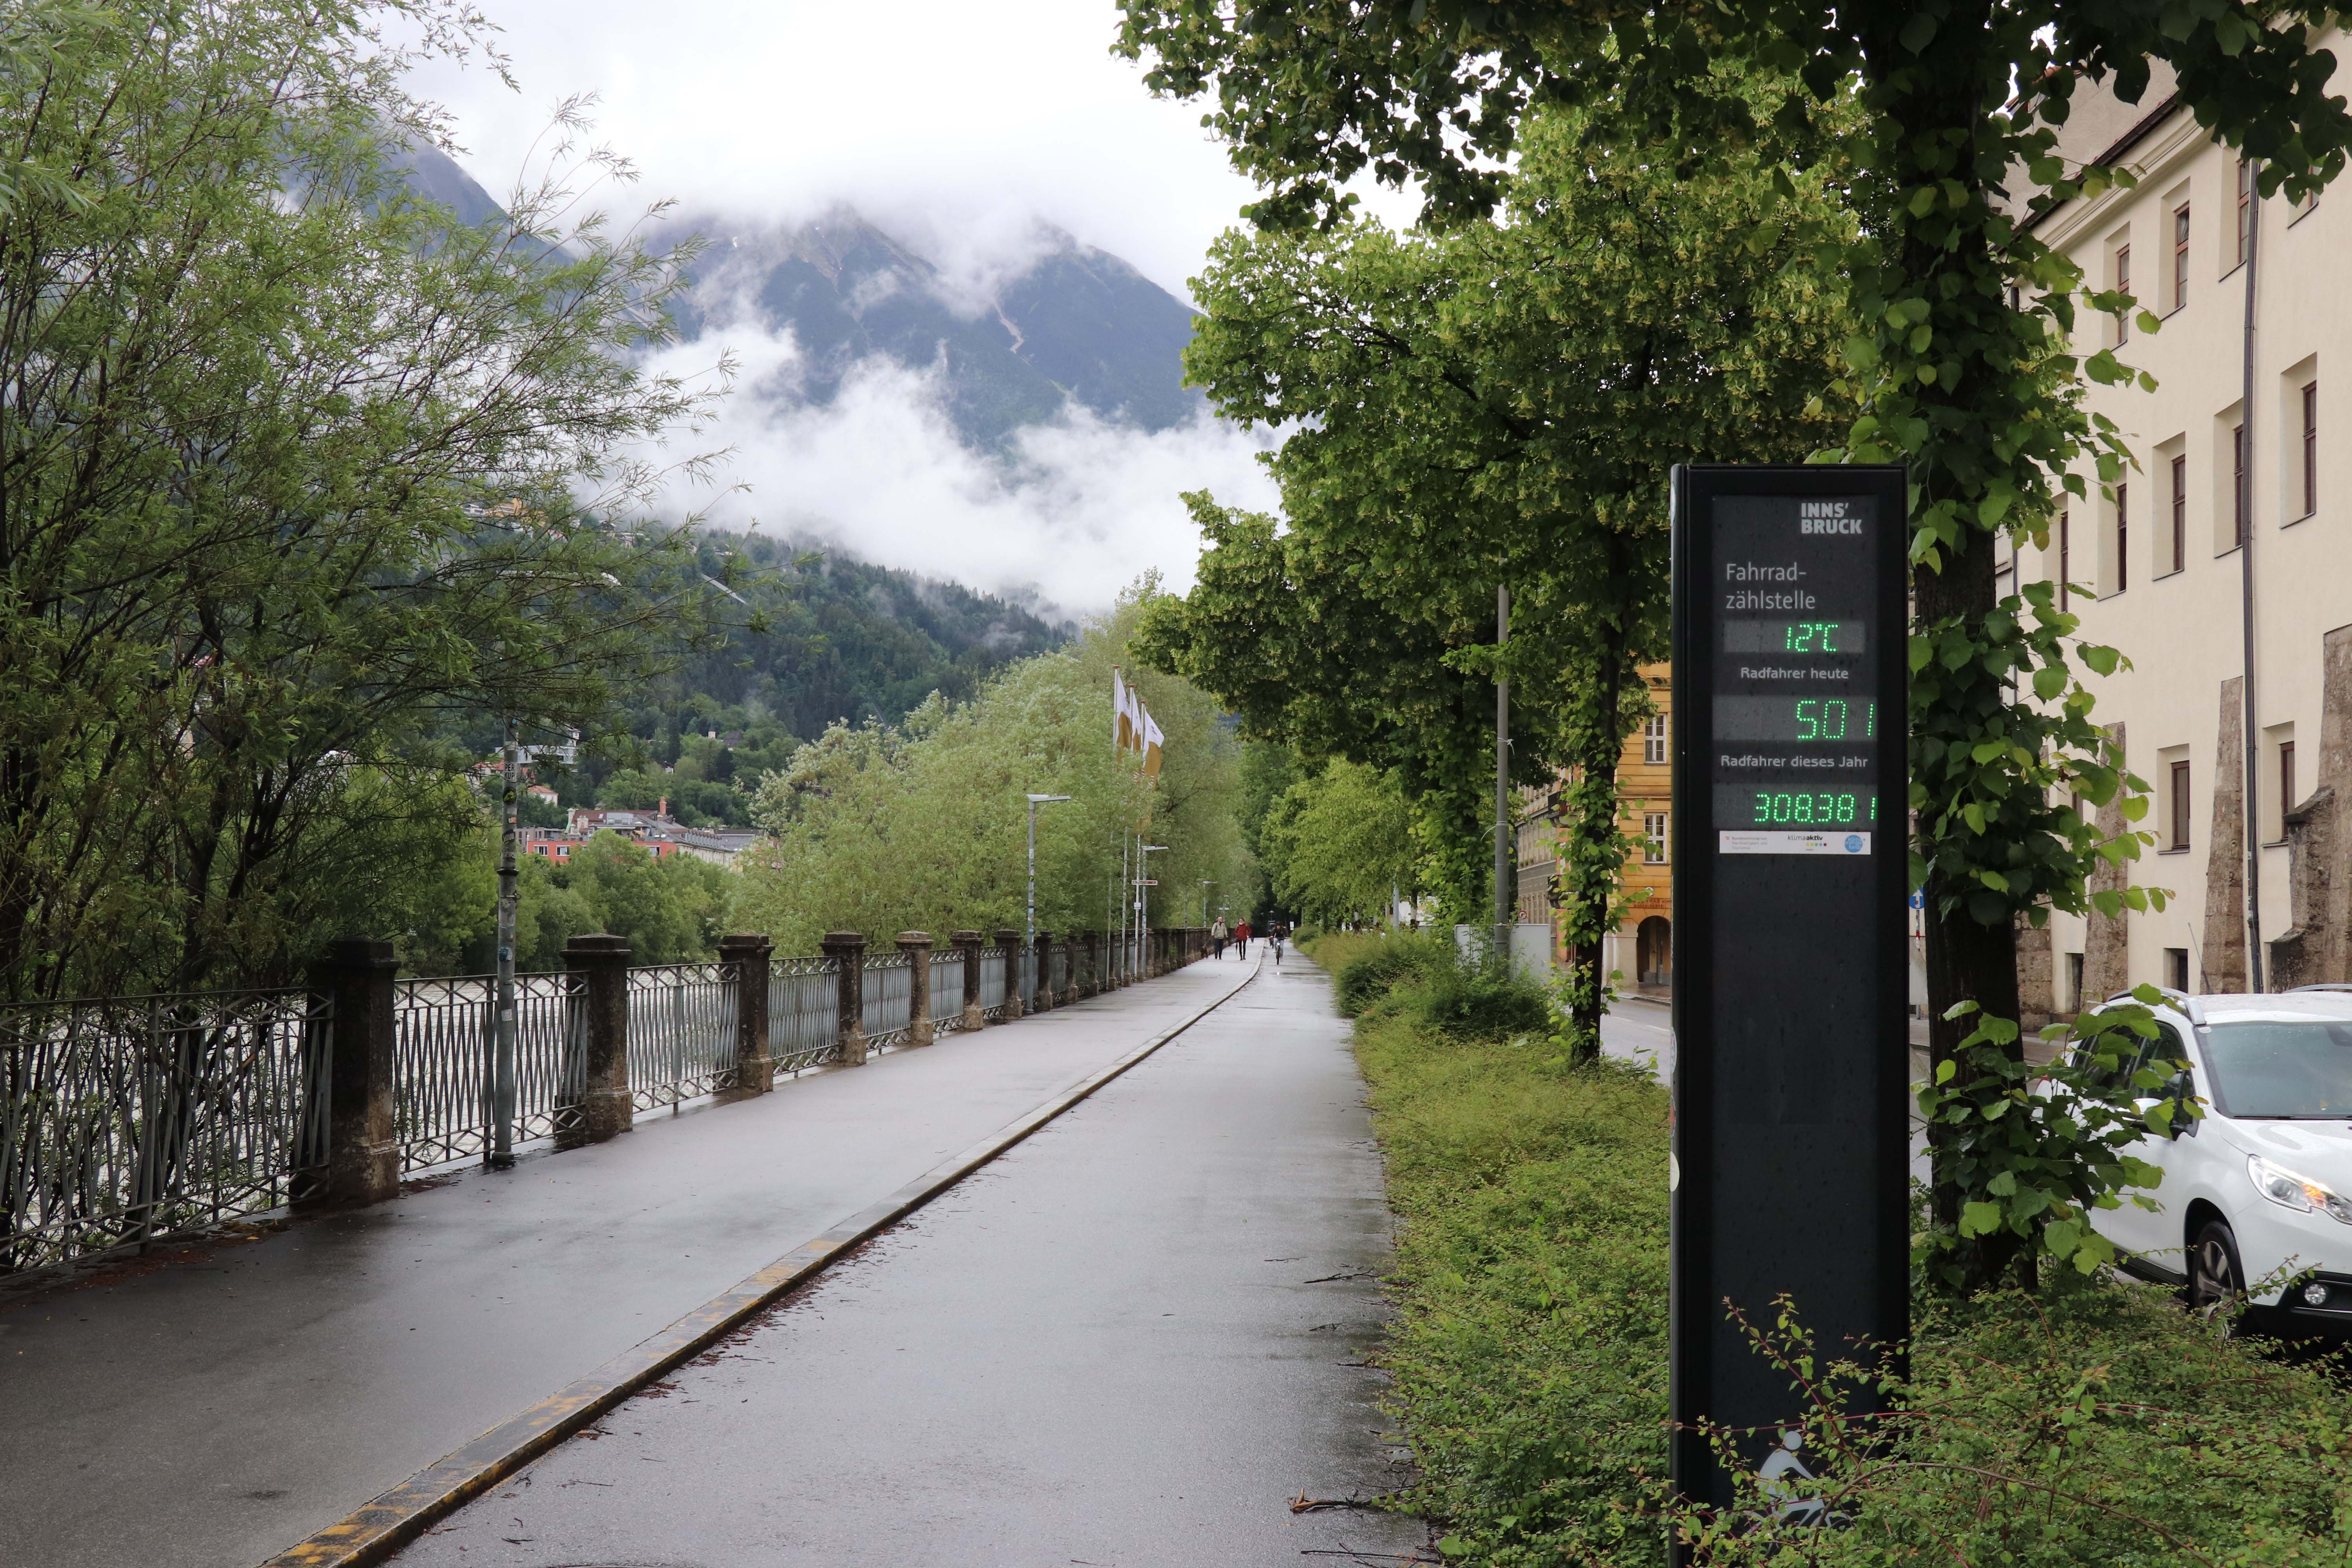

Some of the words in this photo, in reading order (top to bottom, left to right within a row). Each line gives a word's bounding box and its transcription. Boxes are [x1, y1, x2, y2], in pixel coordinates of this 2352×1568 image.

[1801, 519, 1862, 534] BRUCK
[1726, 562, 1807, 581] Fahrrad-
[1726, 590, 1815, 609] zählstelle
[1740, 667, 1806, 679] Radfahrer
[1811, 668, 1849, 679] heute
[1796, 700, 1874, 739] 501
[1721, 755, 1786, 767] Radfahrer
[1791, 756, 1835, 768] dieses
[1839, 756, 1868, 768] Jahr
[1755, 793, 1877, 823] 308.381
